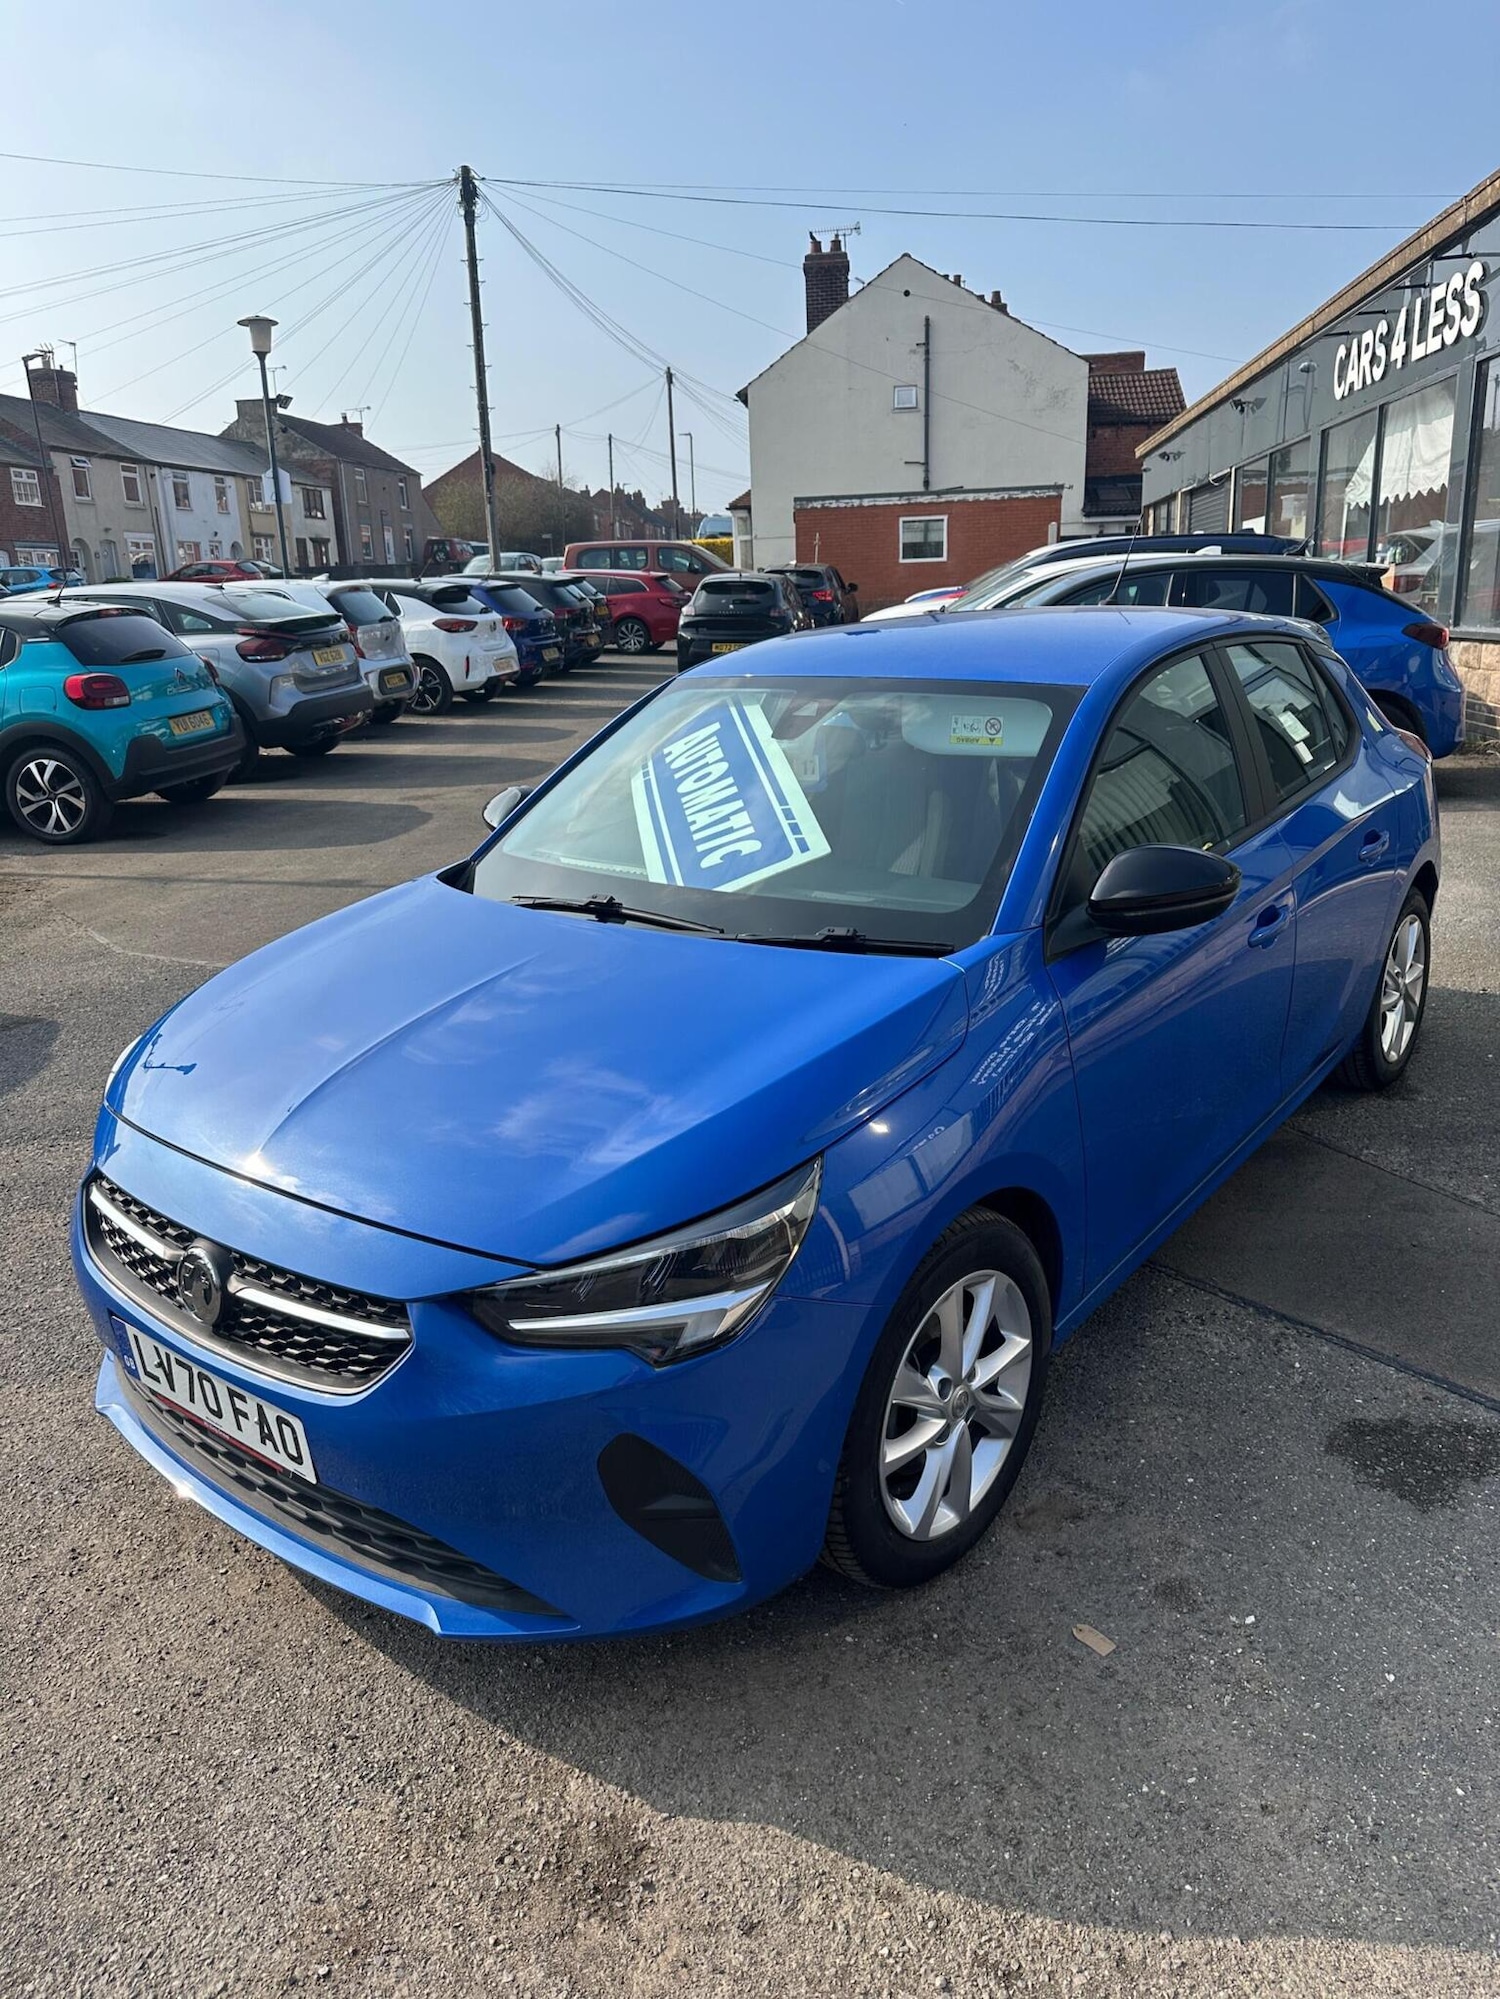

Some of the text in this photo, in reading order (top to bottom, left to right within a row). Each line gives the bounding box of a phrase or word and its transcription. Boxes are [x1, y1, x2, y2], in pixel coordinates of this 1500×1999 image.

[1333, 261, 1484, 401] CARS 4 LESS
[663, 721, 763, 870] AUTOMATIC
[123, 1354, 136, 1371] GB
[133, 1333, 304, 1466] LV70 FAO
